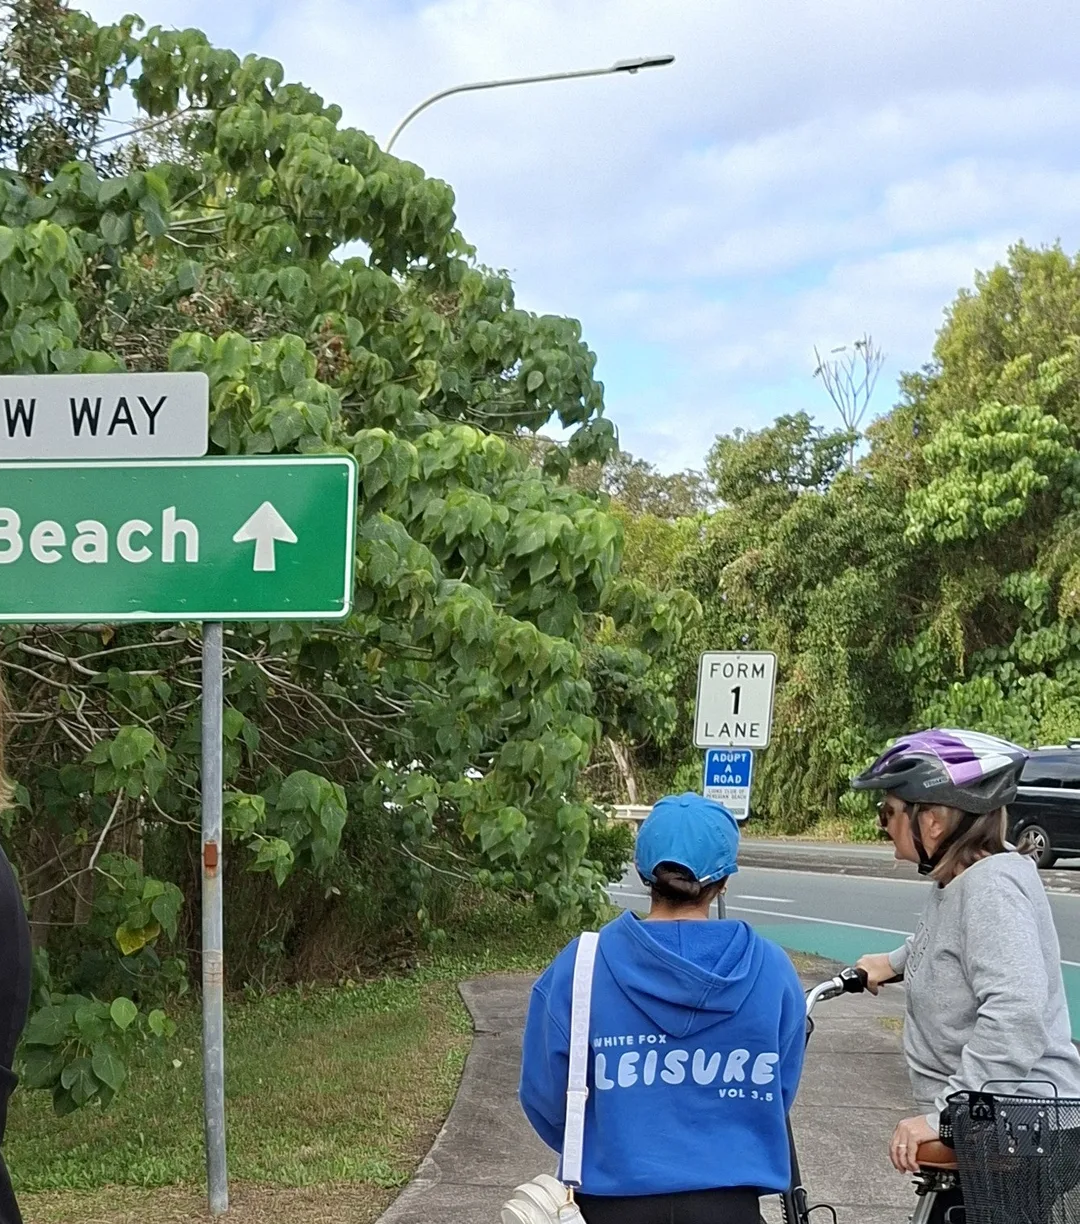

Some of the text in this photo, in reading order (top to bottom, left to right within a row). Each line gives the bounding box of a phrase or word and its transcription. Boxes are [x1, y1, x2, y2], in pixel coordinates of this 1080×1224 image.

[69, 395, 168, 437] WAY
[709, 662, 765, 678] FORM
[730, 686, 741, 715] 1
[704, 722, 760, 738] LANE
[724, 764, 732, 773] A
[713, 774, 742, 784] ROAD
[593, 1034, 667, 1047] WHITE FOX
[594, 1048, 780, 1090] LEISURE
[718, 1088, 774, 1102] VOL 3.5
